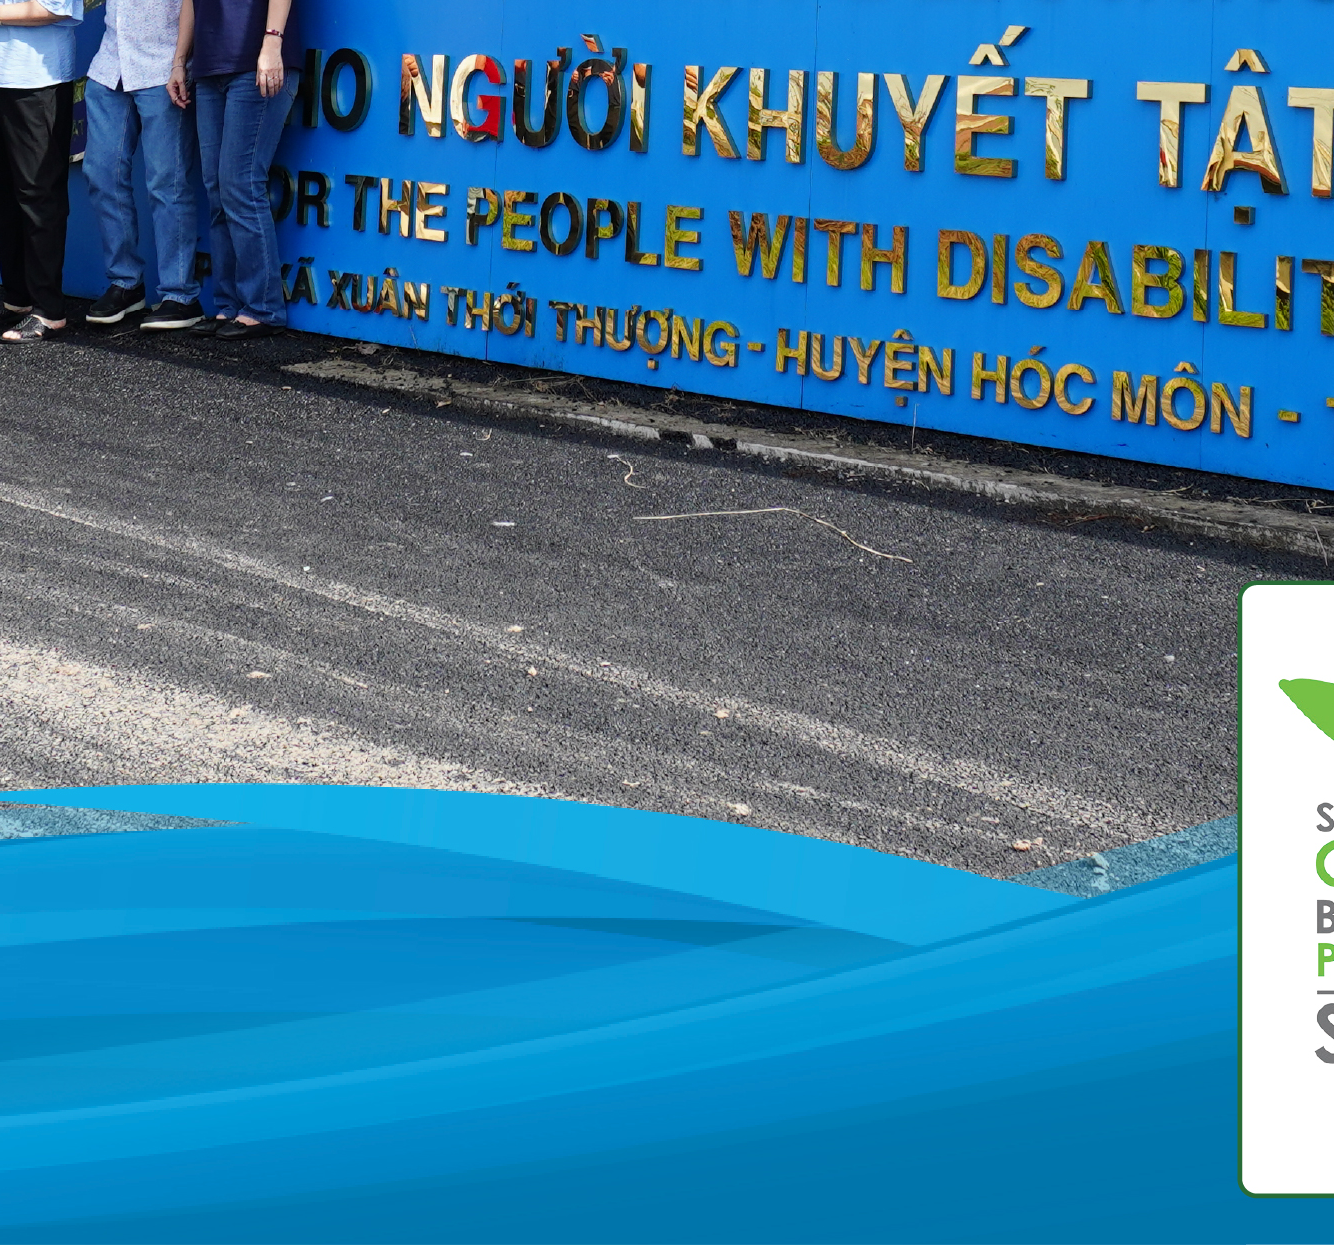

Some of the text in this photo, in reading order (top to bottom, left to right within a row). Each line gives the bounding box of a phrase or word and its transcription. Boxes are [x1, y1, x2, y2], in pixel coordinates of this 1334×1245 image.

[284, 47, 372, 132] HO
[399, 33, 652, 154] NGƯỜI
[681, 25, 1092, 181] KHUYẾT
[267, 164, 330, 228] OR
[345, 173, 450, 243] THE
[465, 186, 705, 272] PEOPLE
[727, 209, 910, 295] WITH
[327, 267, 430, 322] XUÂN
[440, 282, 537, 338] THỚI
[549, 300, 740, 370] THƯỢNG
[774, 328, 954, 408] HUYỆN
[971, 345, 1098, 416] HÓC
[1111, 361, 1255, 439] MÔN
